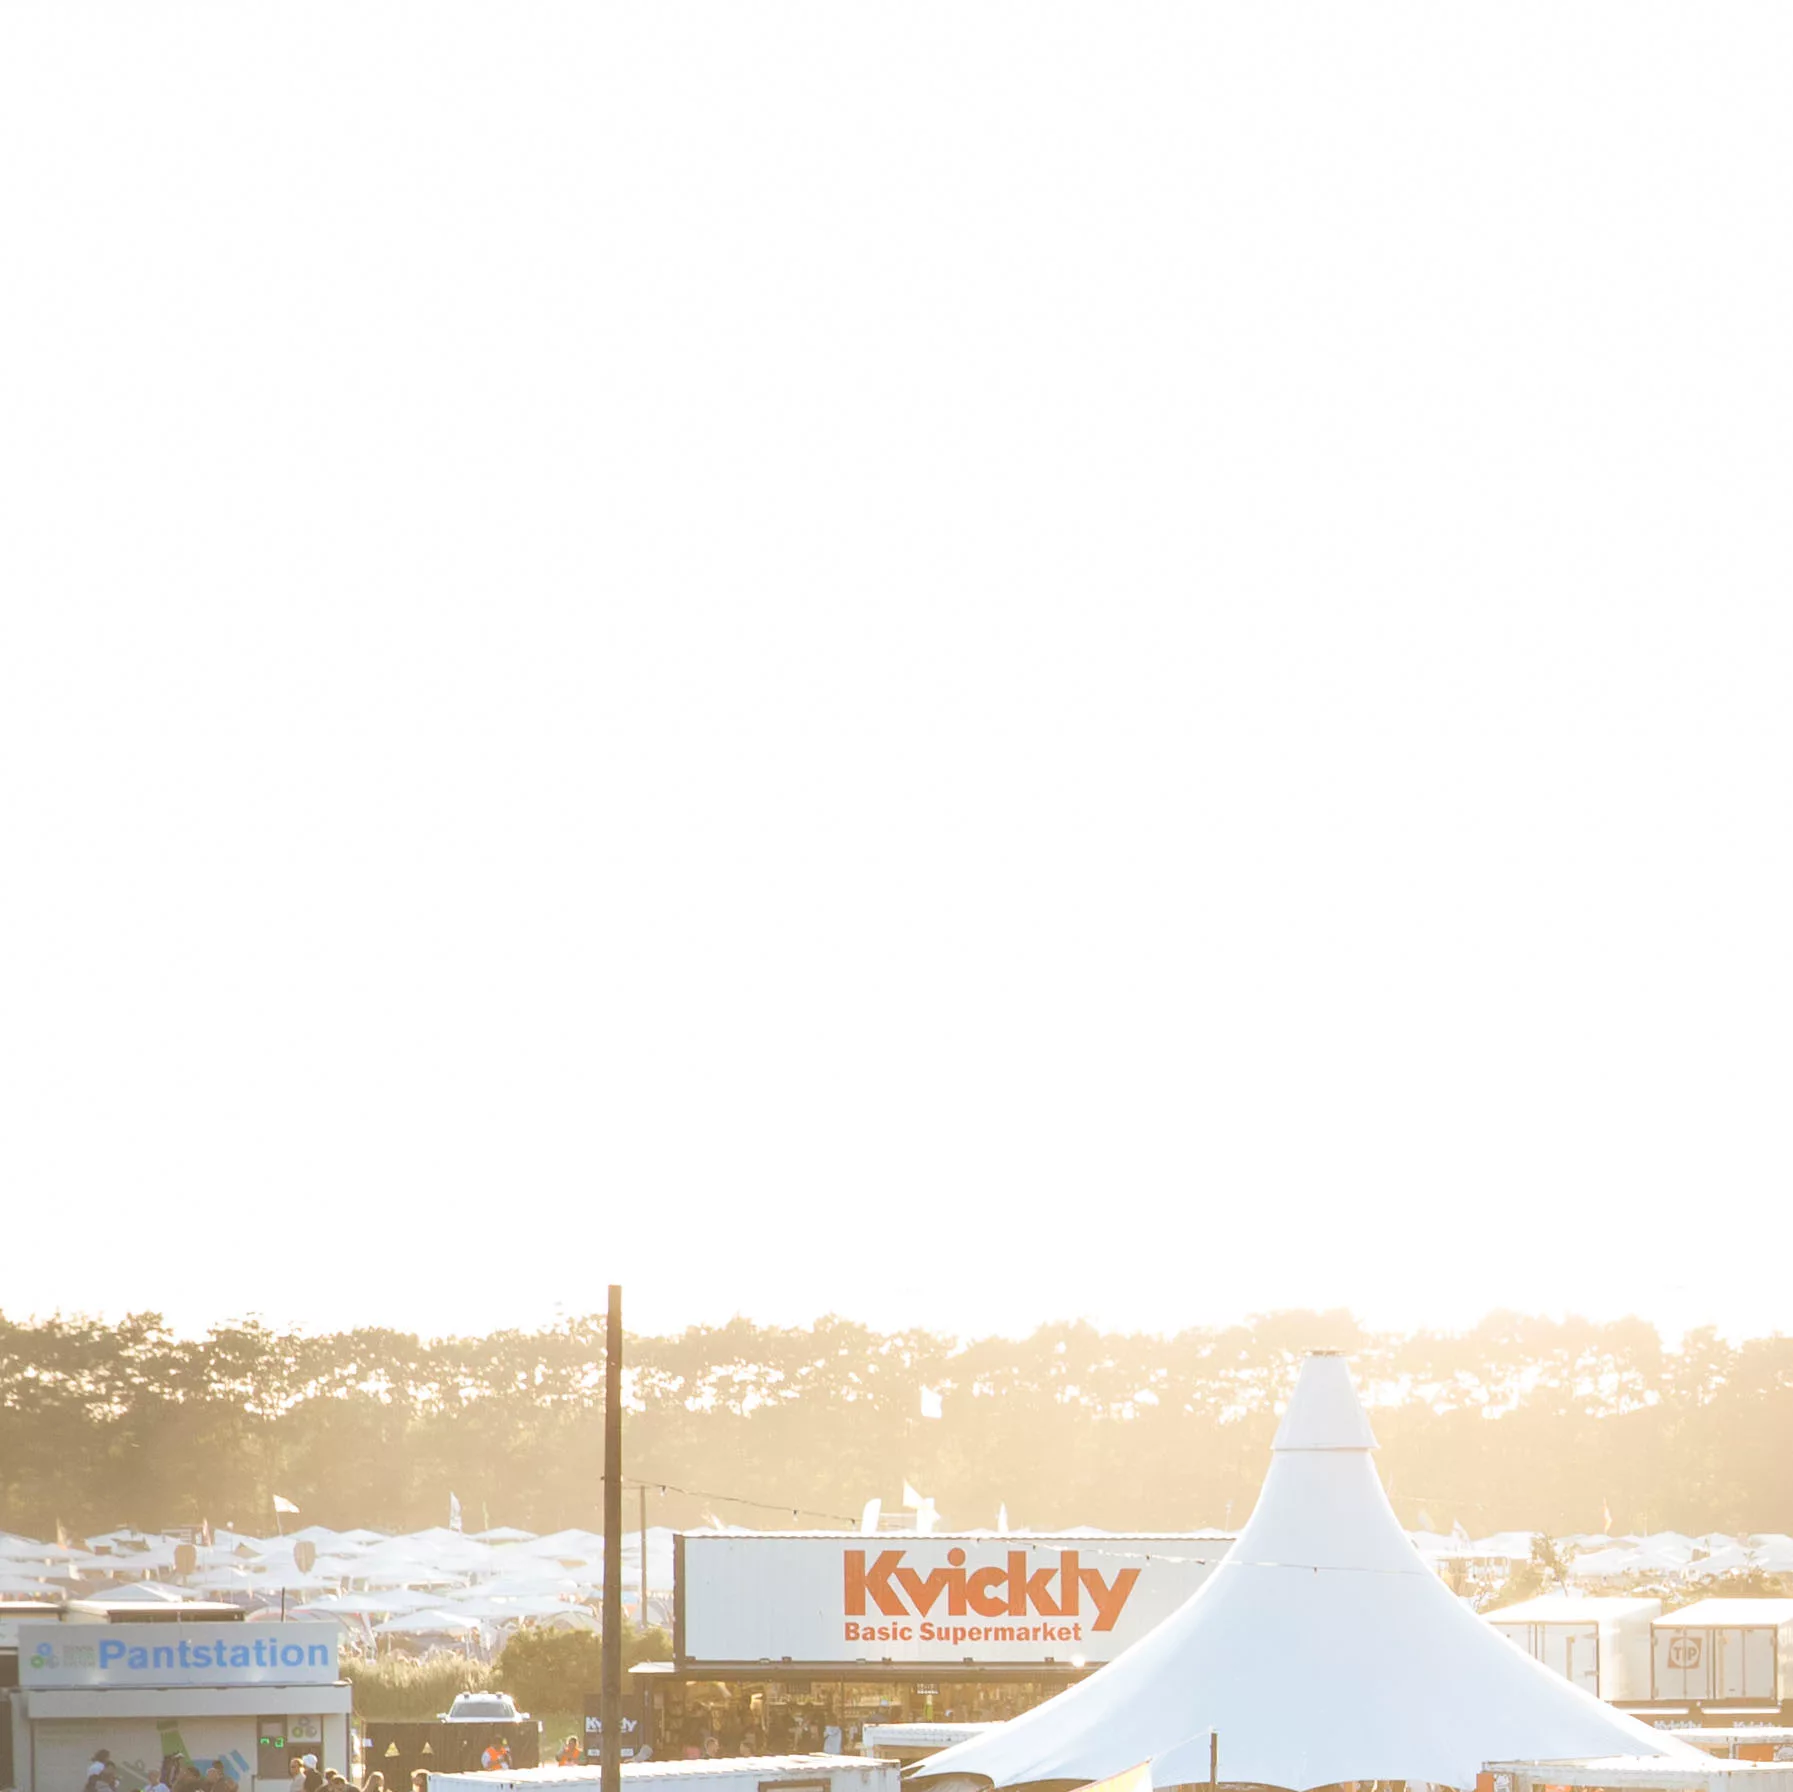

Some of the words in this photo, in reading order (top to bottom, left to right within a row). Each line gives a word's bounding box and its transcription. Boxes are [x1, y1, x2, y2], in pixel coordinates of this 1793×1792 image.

[844, 1547, 1142, 1631] Kvickly
[844, 1622, 912, 1641] Basic
[920, 1622, 1083, 1645] Supermarket
[99, 1637, 330, 1670] Pantstation
[1673, 1647, 1698, 1660] TIP
